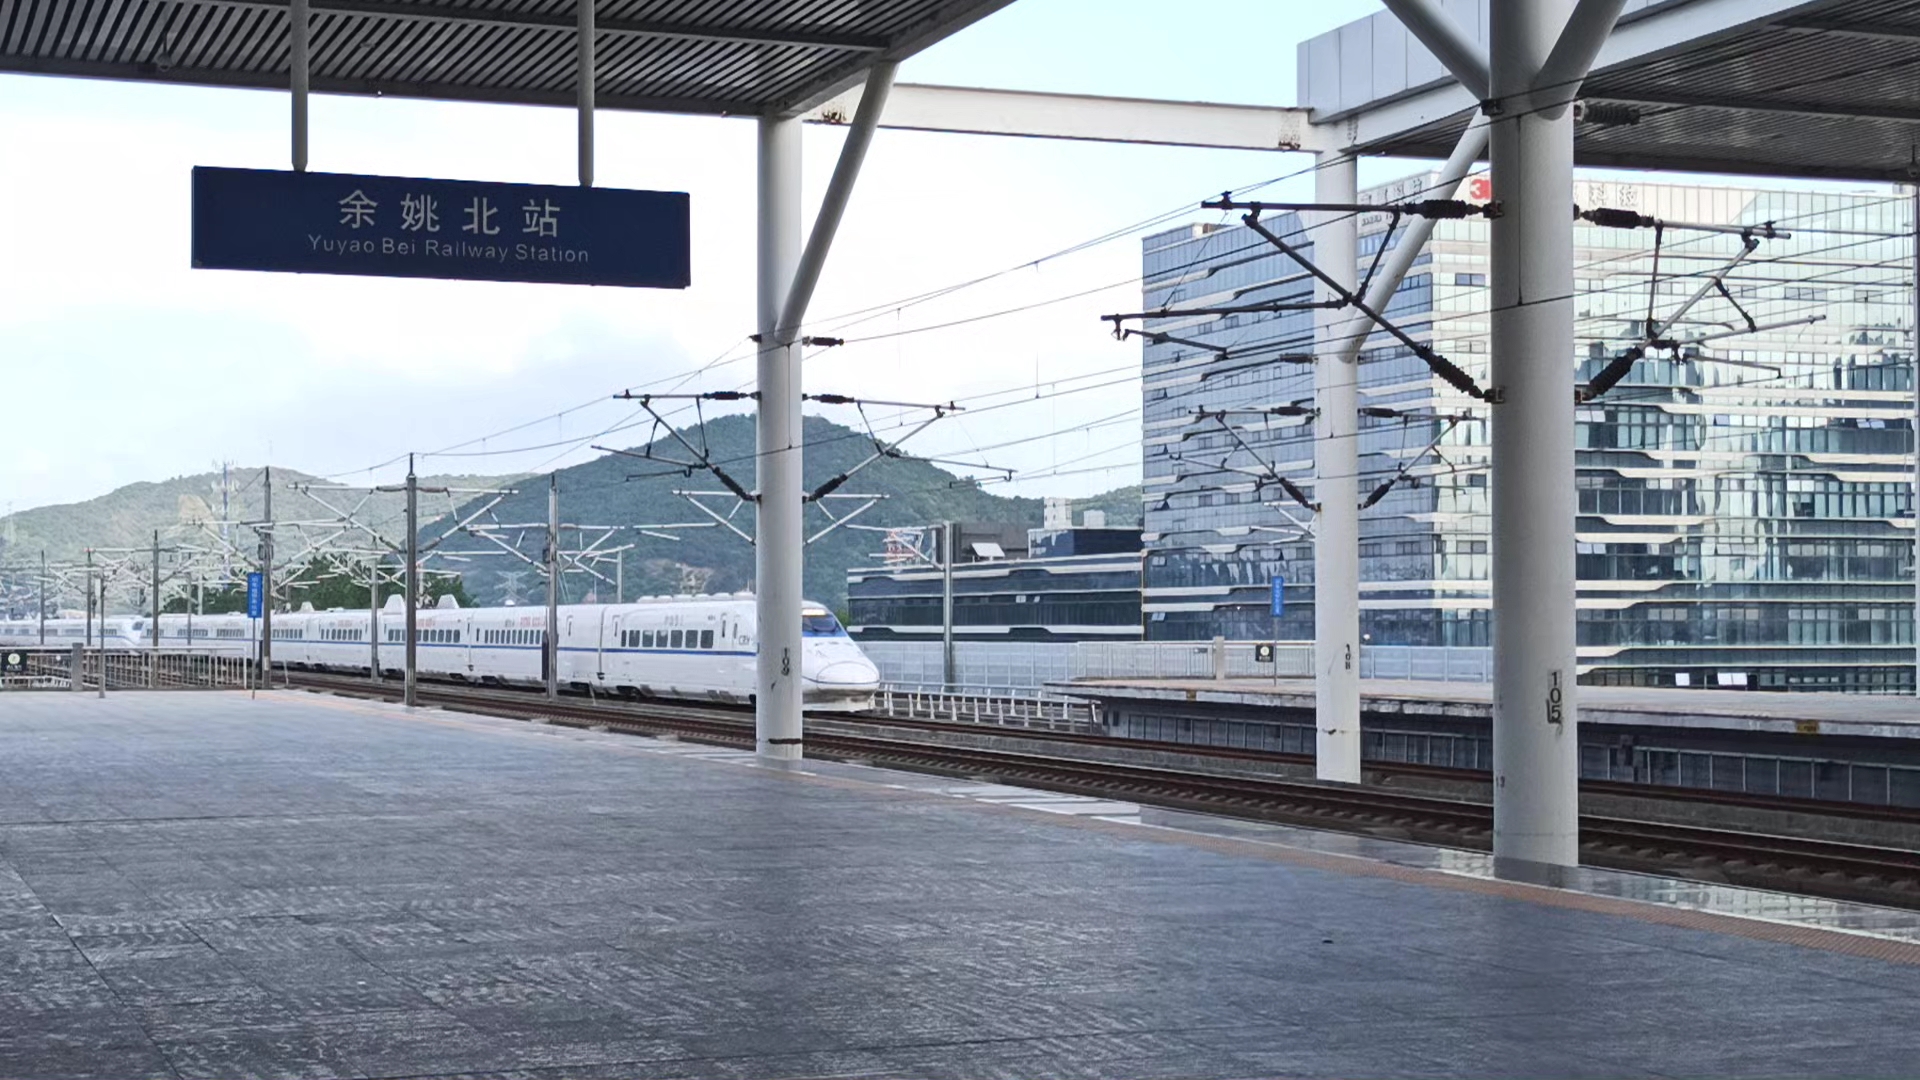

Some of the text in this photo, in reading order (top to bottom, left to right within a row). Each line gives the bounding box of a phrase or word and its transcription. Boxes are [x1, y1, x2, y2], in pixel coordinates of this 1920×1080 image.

[338, 189, 561, 237] 余姚北站
[307, 234, 589, 263] Yuyao Bei Railway Station
[1550, 671, 1562, 721] 105
